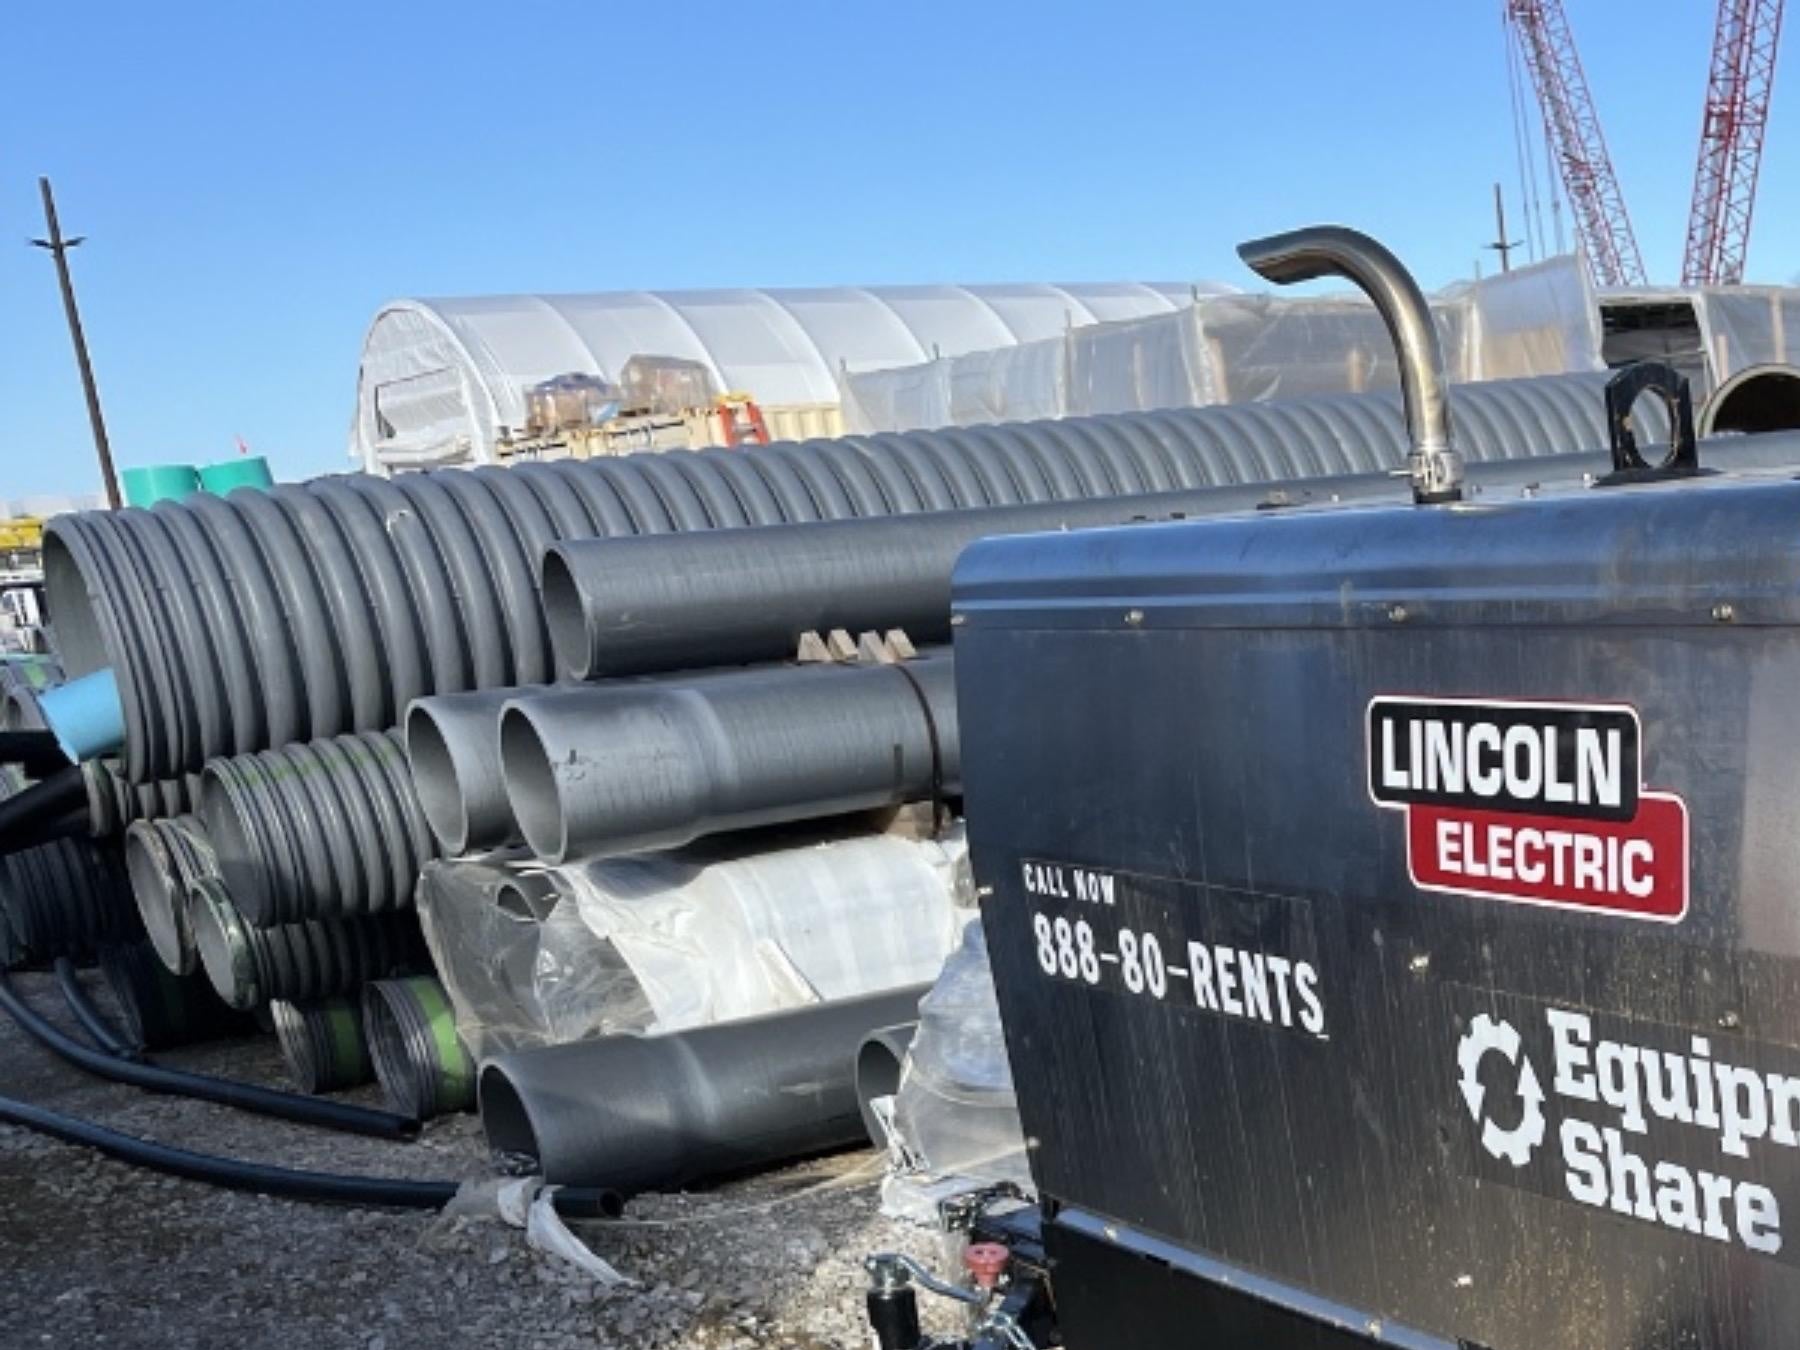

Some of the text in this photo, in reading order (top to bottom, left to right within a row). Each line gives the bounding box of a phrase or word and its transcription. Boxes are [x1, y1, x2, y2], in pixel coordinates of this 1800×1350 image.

[1381, 717, 1622, 808] LINCOLN
[1022, 862, 1115, 905] CALL NOW
[1435, 818, 1655, 899] ELECTRIC
[1033, 911, 1326, 1035] 888-80-RENTS
[1559, 1117, 1784, 1256] Share
